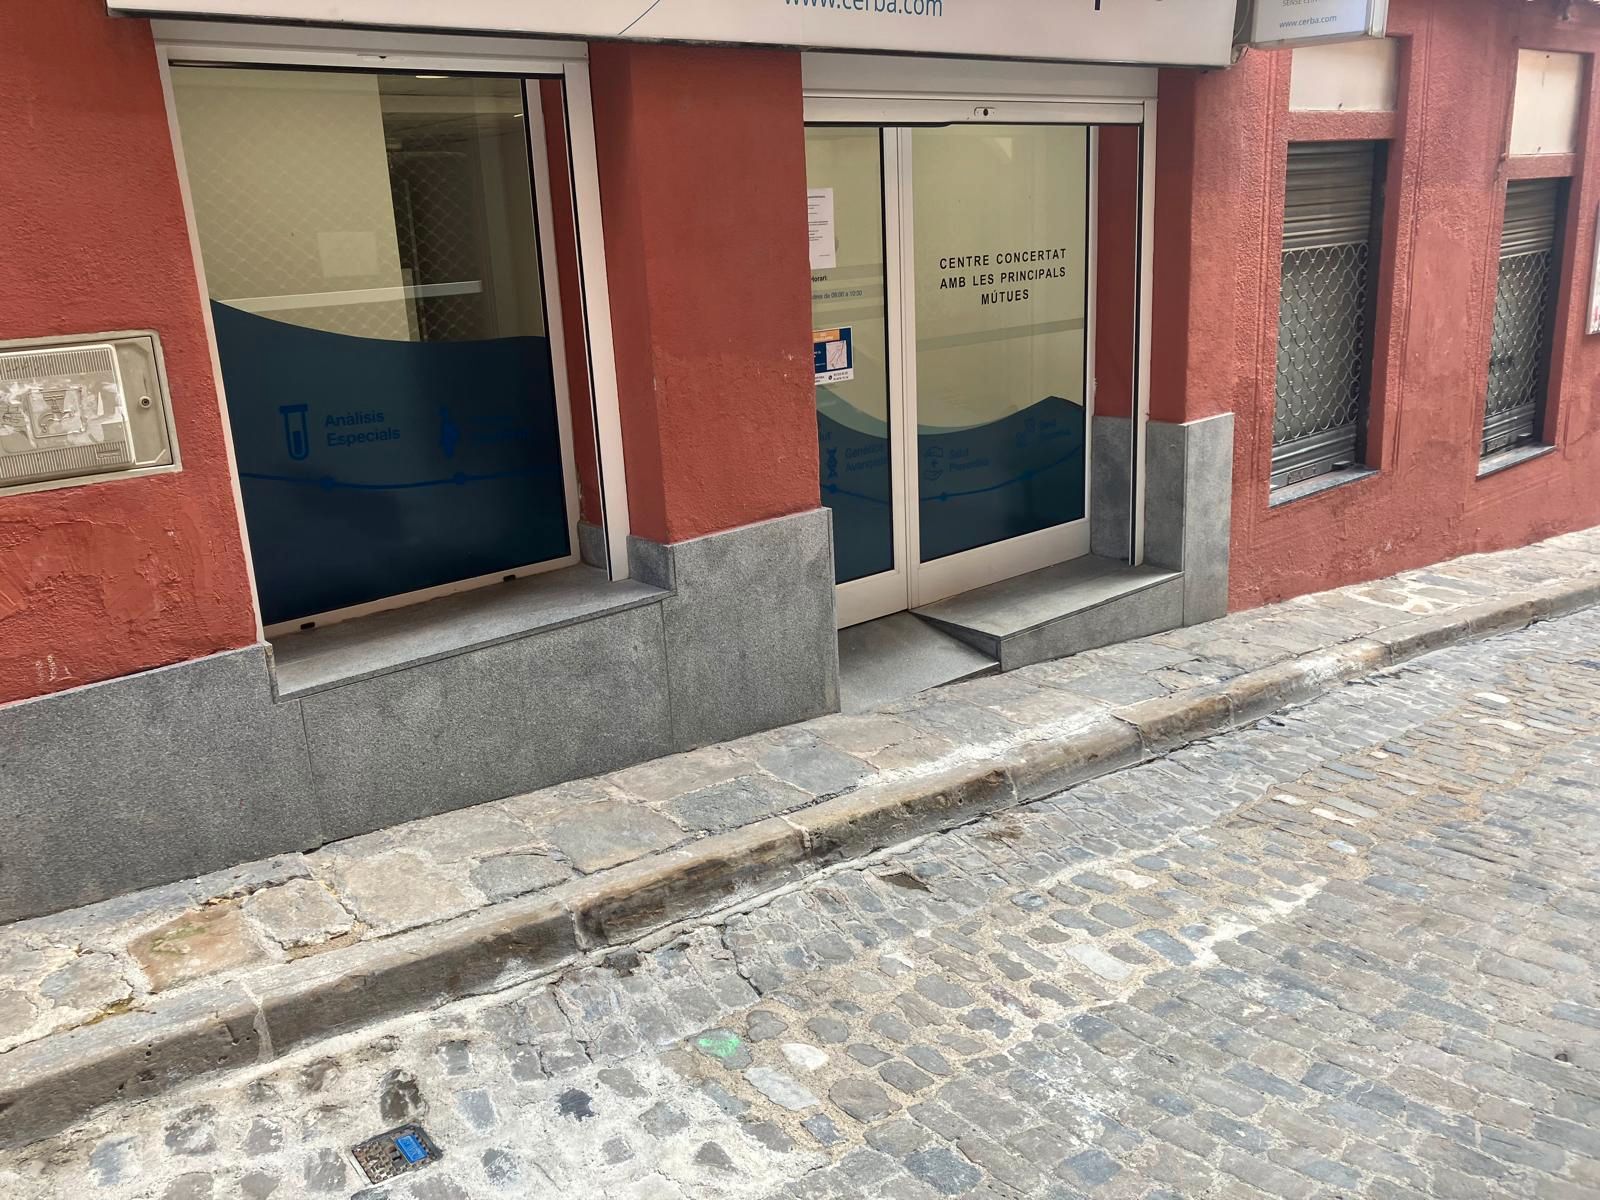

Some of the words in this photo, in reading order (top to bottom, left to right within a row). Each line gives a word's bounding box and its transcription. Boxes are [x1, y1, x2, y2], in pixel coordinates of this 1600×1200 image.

[784, 0, 939, 17] .cerba.com
[1279, 15, 1337, 28] www.cerba.com
[939, 254, 990, 270] CENTRE
[996, 248, 1067, 265] CONCERTAT
[939, 276, 966, 290] AMB
[972, 273, 994, 287] LES
[1000, 266, 1066, 284] PRINCIPALS
[981, 289, 1029, 305] MÚTUES
[324, 409, 385, 428] Anàlisis
[326, 427, 401, 448] Especials
